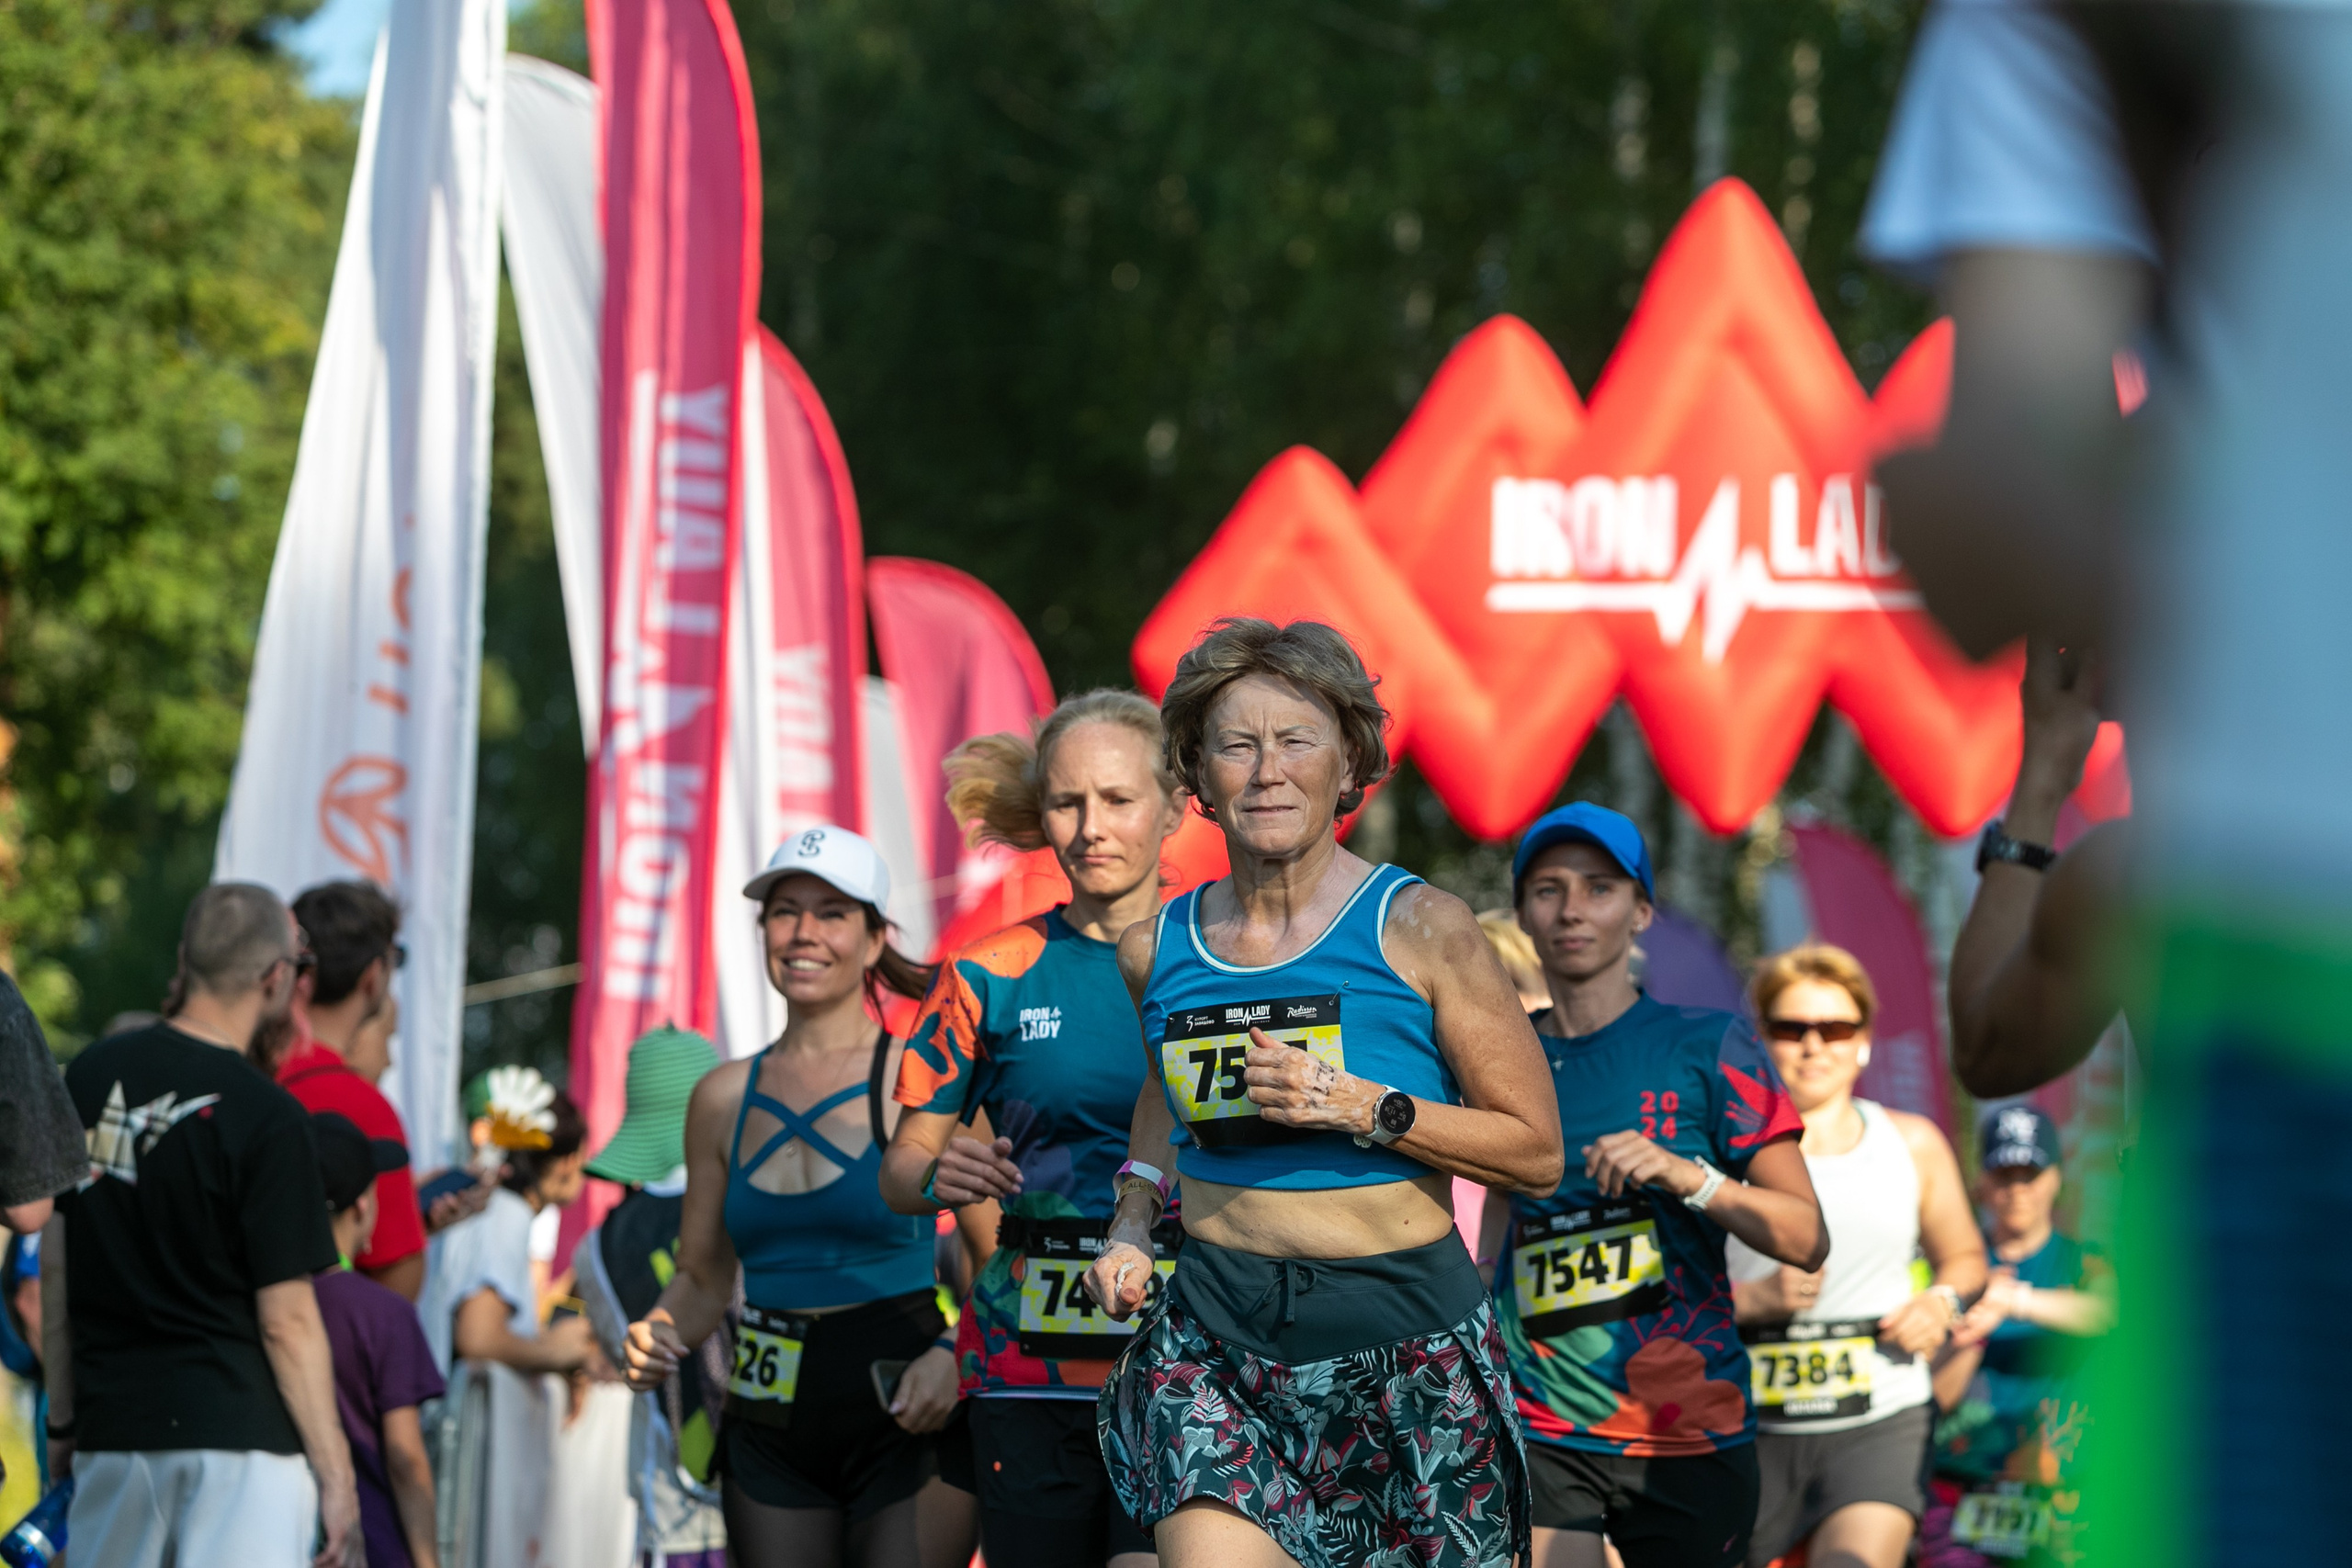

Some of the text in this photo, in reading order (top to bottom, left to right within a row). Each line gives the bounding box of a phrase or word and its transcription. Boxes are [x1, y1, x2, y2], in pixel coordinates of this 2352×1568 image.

[1489, 474, 1678, 577] IRON
[1019, 1007, 1050, 1022] IRON
[1020, 1020, 1061, 1042] LADY
[1226, 1005, 1271, 1020] IRON LADY
[1528, 1235, 1631, 1298] 7547
[1041, 1269, 1164, 1318] 749
[1759, 1350, 1854, 1389] 7384
